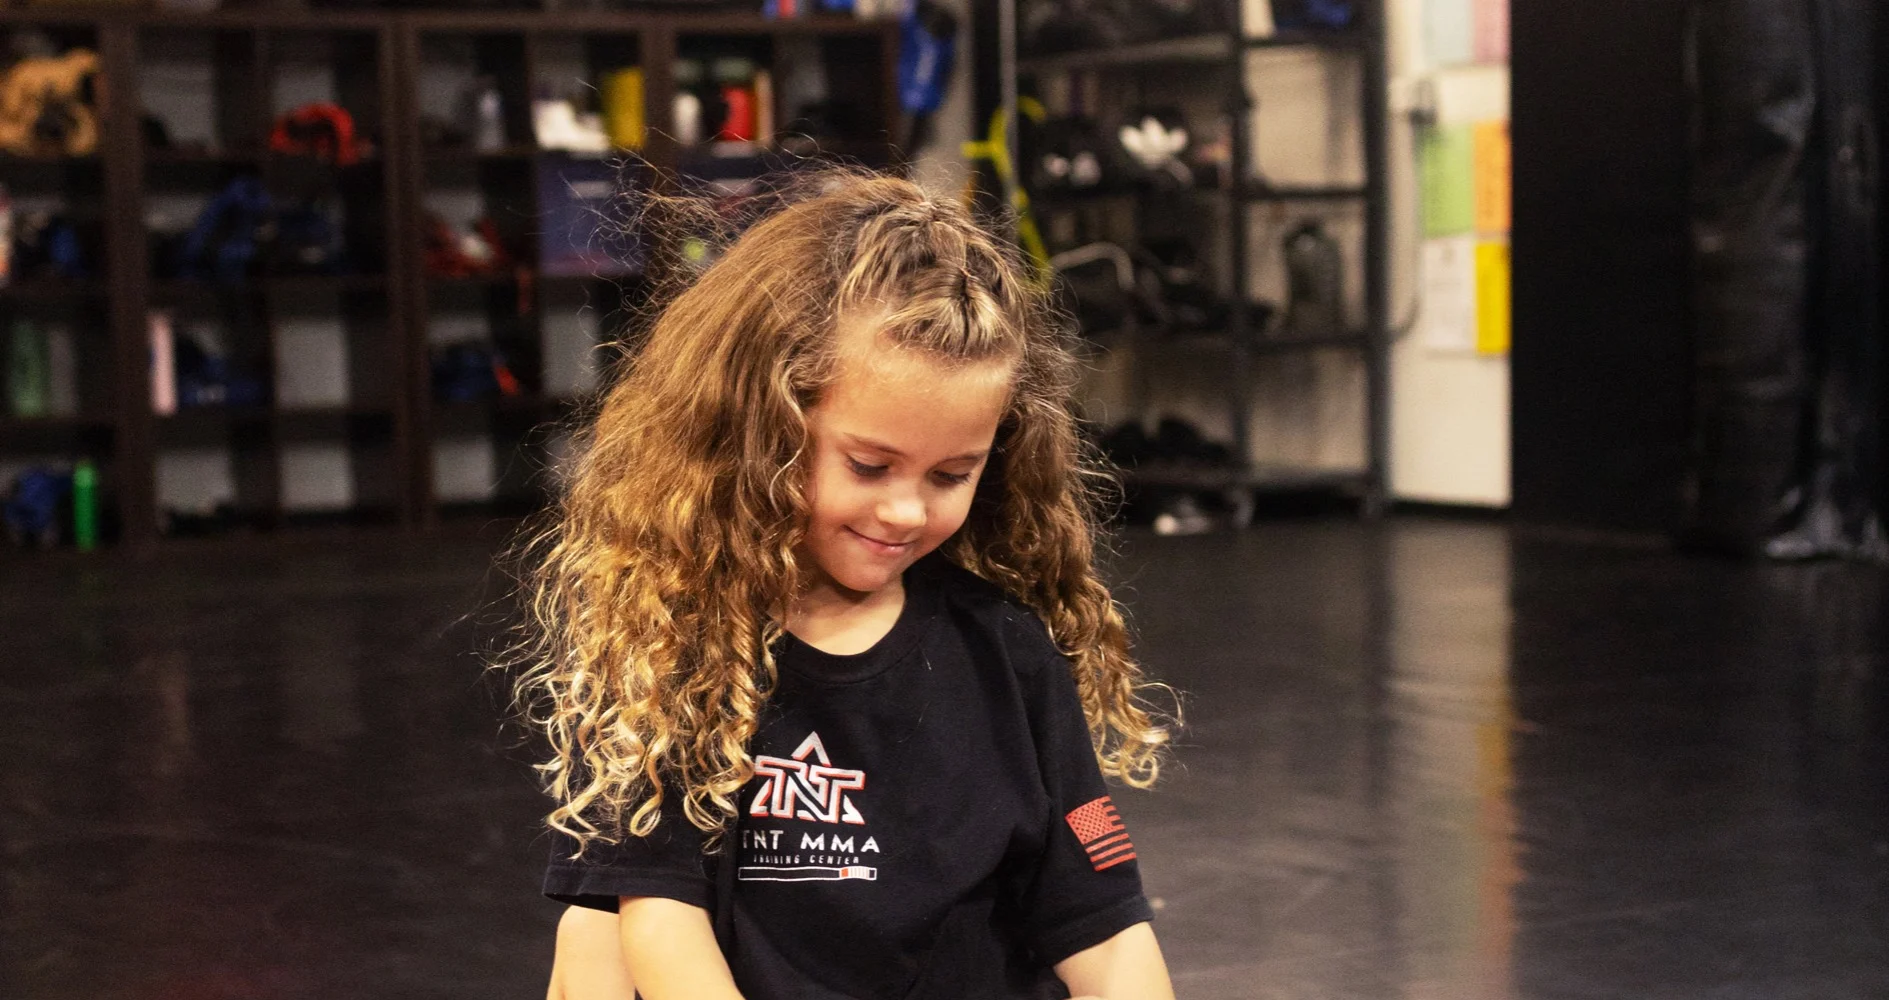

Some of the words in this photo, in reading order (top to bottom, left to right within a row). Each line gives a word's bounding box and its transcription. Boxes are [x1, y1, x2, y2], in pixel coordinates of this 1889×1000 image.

[743, 829, 784, 850] TNT
[800, 831, 880, 853] MMA
[809, 855, 859, 865] CENTER
